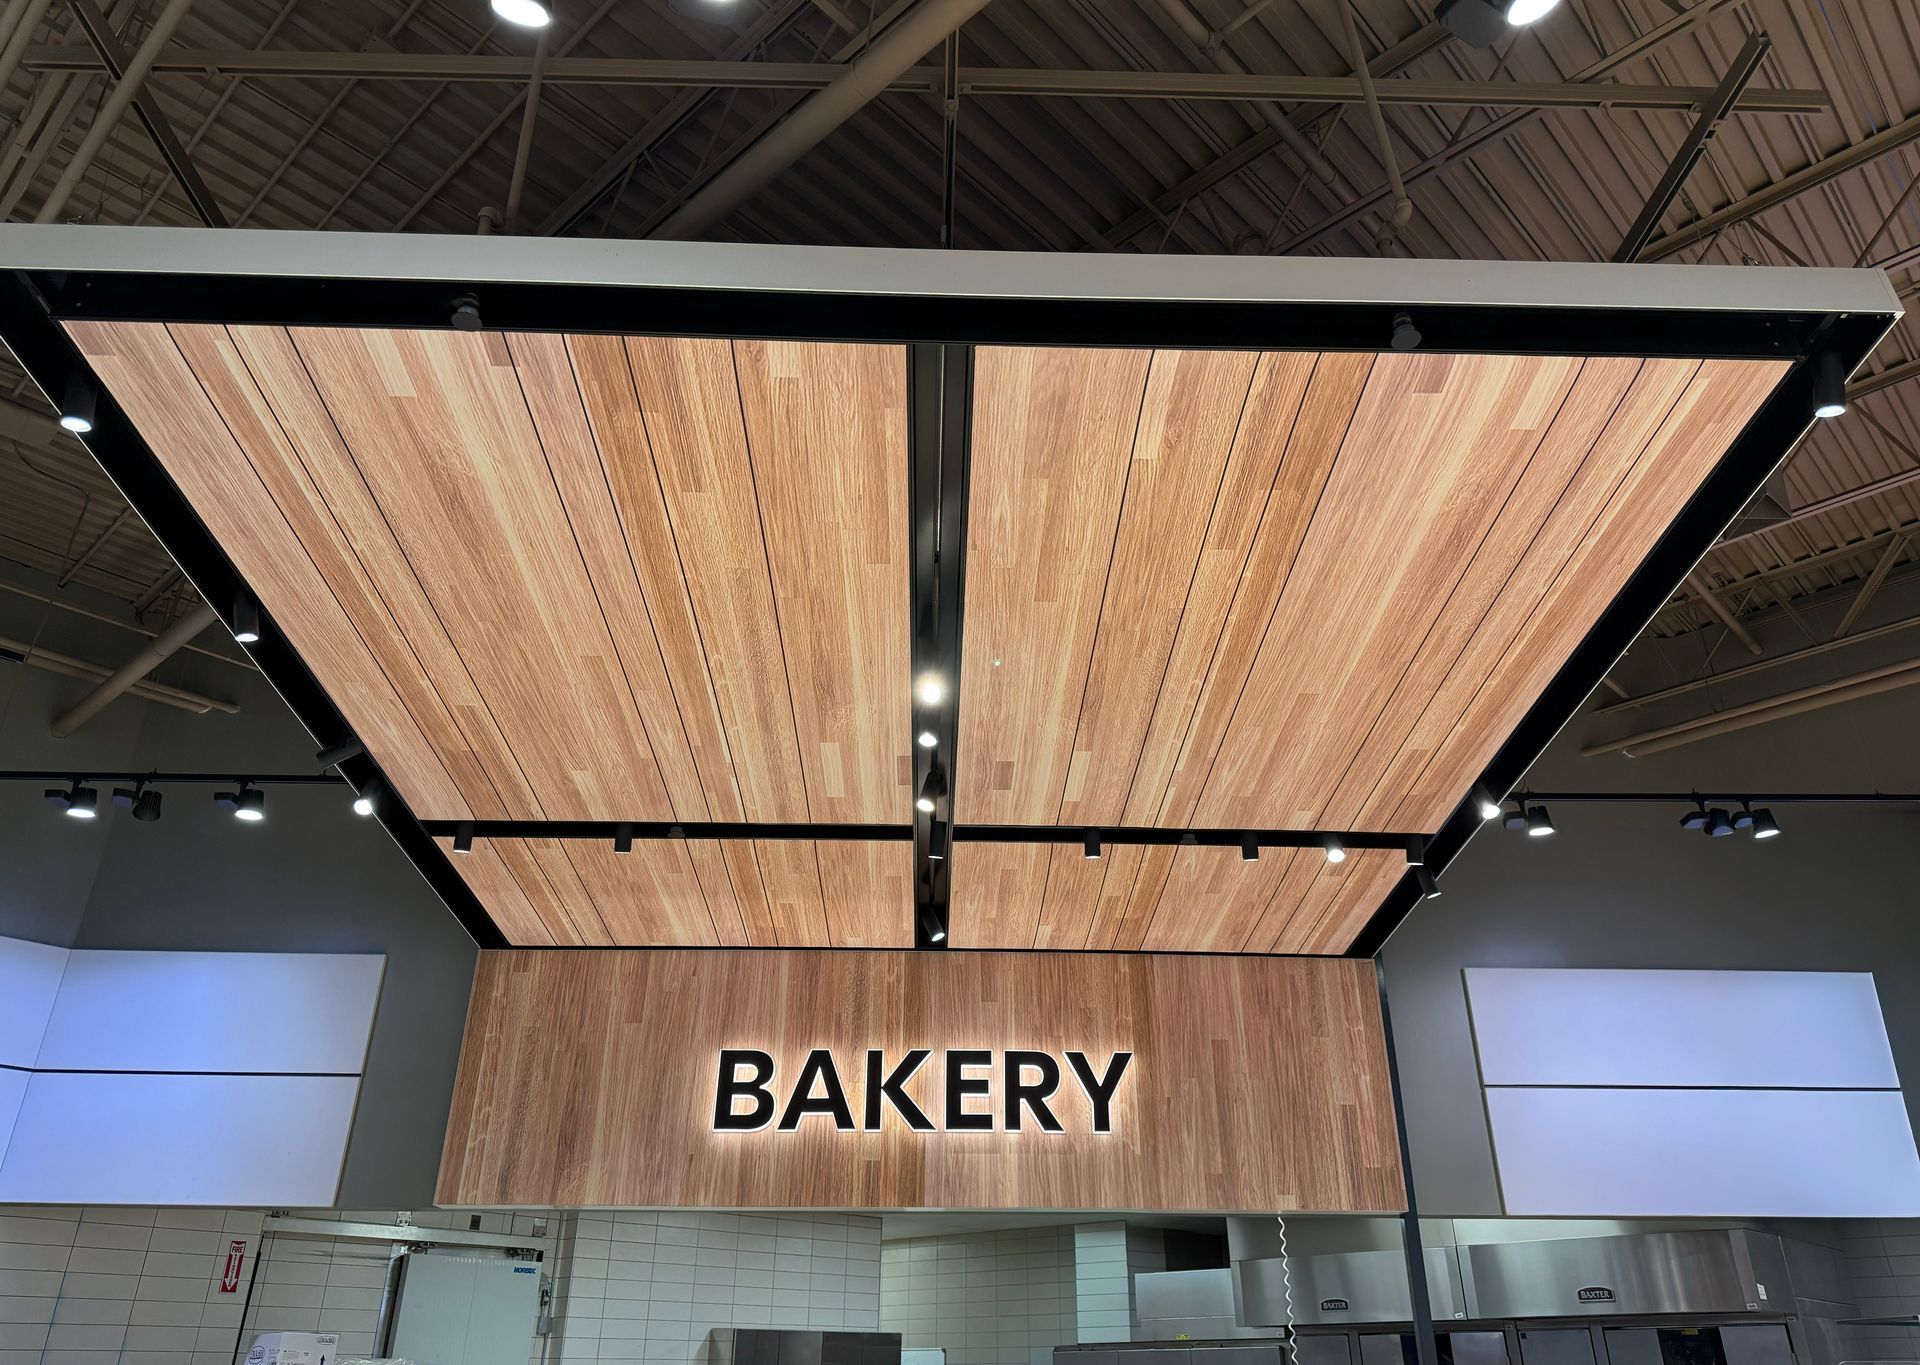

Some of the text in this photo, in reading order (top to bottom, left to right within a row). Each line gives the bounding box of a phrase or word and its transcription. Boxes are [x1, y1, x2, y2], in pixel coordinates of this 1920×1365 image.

[713, 1049, 1133, 1134] BAKERY
[231, 1245, 243, 1253] FIRE
[513, 1266, 536, 1274] NORBEC
[1581, 1290, 1610, 1298] BAXTER
[1322, 1301, 1347, 1309] BAXTER
